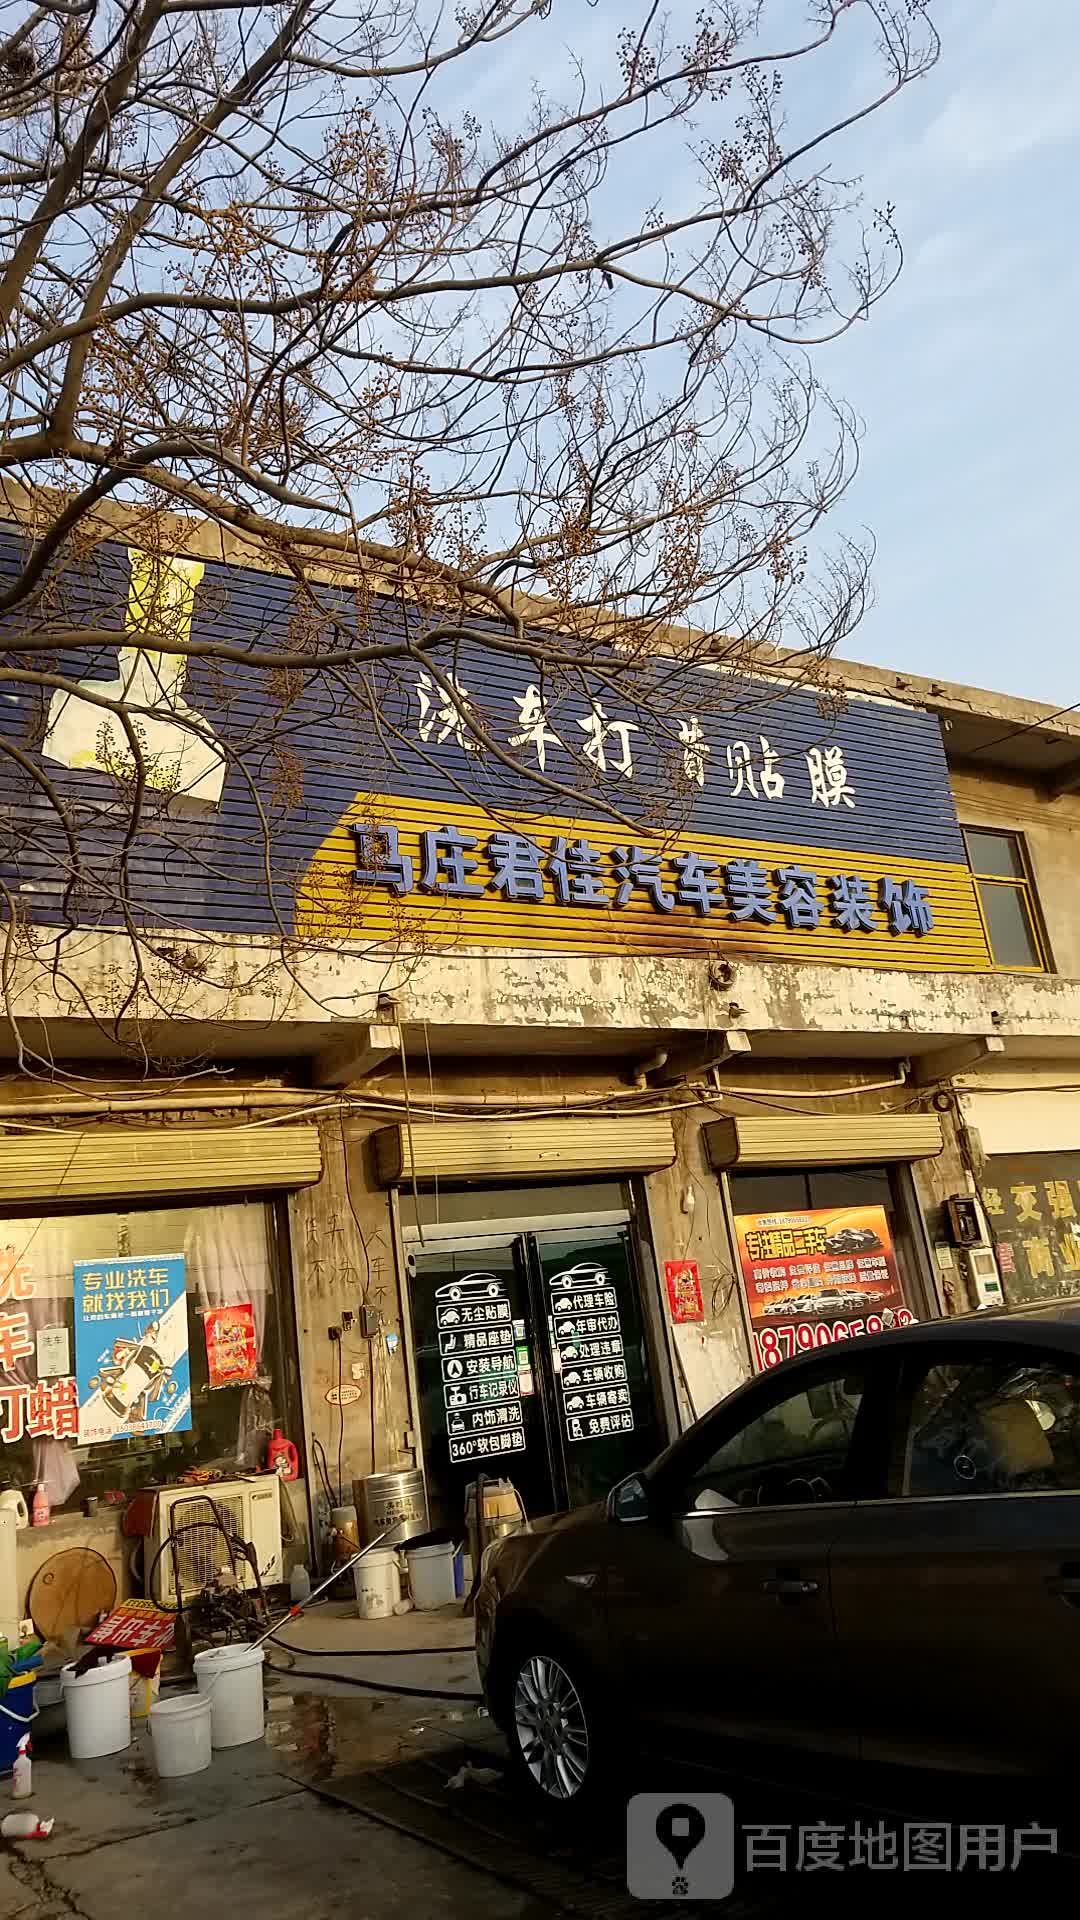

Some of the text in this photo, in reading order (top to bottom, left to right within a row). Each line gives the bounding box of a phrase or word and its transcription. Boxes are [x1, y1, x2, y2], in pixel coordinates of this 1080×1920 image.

[352, 823, 934, 937] 马庄君佳汽车美容装饰
[83, 1268, 169, 1290] 专业洗车
[83, 1288, 169, 1313] 就找我们
[573, 1291, 614, 1309] 代理车险
[462, 1303, 509, 1322] 无尘贴膜
[576, 1316, 618, 1333] 年审代办
[464, 1330, 512, 1349] 精品座垫
[579, 1339, 622, 1358] 处理违章
[466, 1355, 514, 1375] 安装导航
[582, 1364, 625, 1383] 车辆收购
[469, 1379, 518, 1400] 行车记录仪
[585, 1389, 628, 1408] 车辆寄卖
[472, 1405, 520, 1428] 内饰清洗
[589, 1413, 632, 1434] 免费评估
[452, 1431, 524, 1456] 360°软包脚垫
